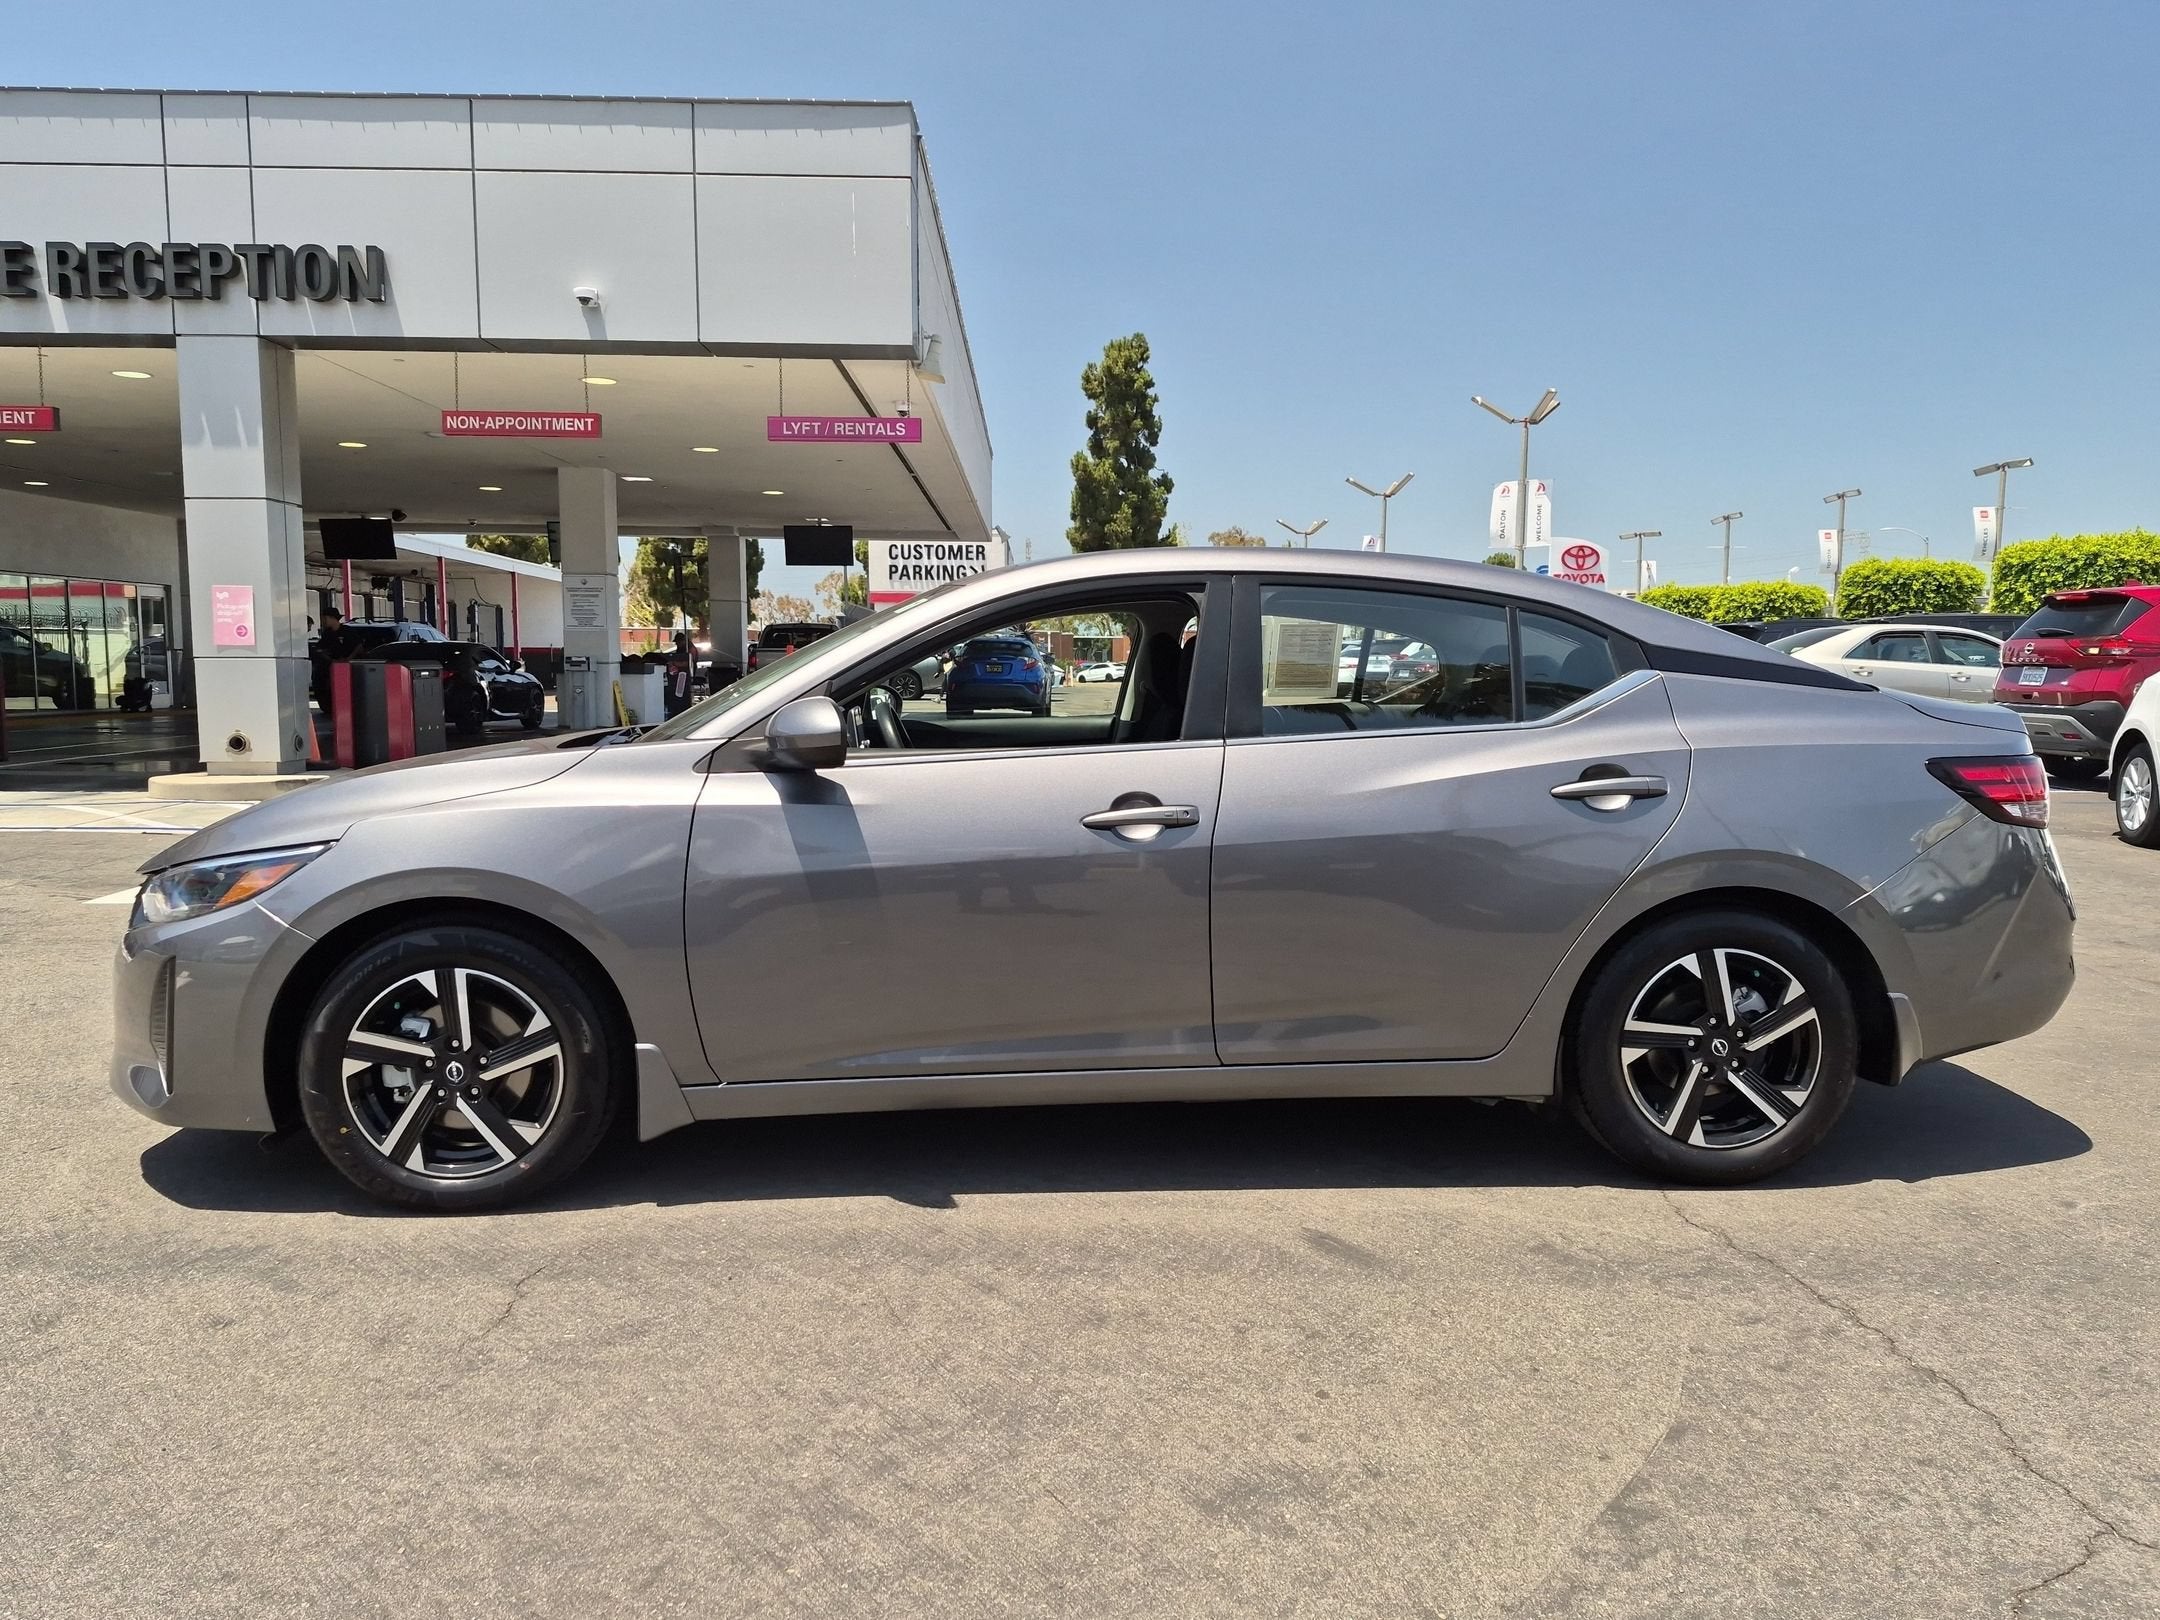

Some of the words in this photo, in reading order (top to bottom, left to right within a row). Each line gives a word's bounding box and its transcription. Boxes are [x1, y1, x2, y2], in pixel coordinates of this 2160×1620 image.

[46, 240, 385, 301] RECEPTION
[0, 411, 35, 424] ENT
[446, 415, 594, 431] NON-APPOINTMENT
[783, 422, 821, 435] LYFT
[834, 422, 906, 436] RENTALS
[1499, 509, 1507, 539] DALTON
[1535, 503, 1543, 542] WELCOME
[888, 543, 986, 560] CUSTOMER
[888, 564, 967, 581] PARKING
